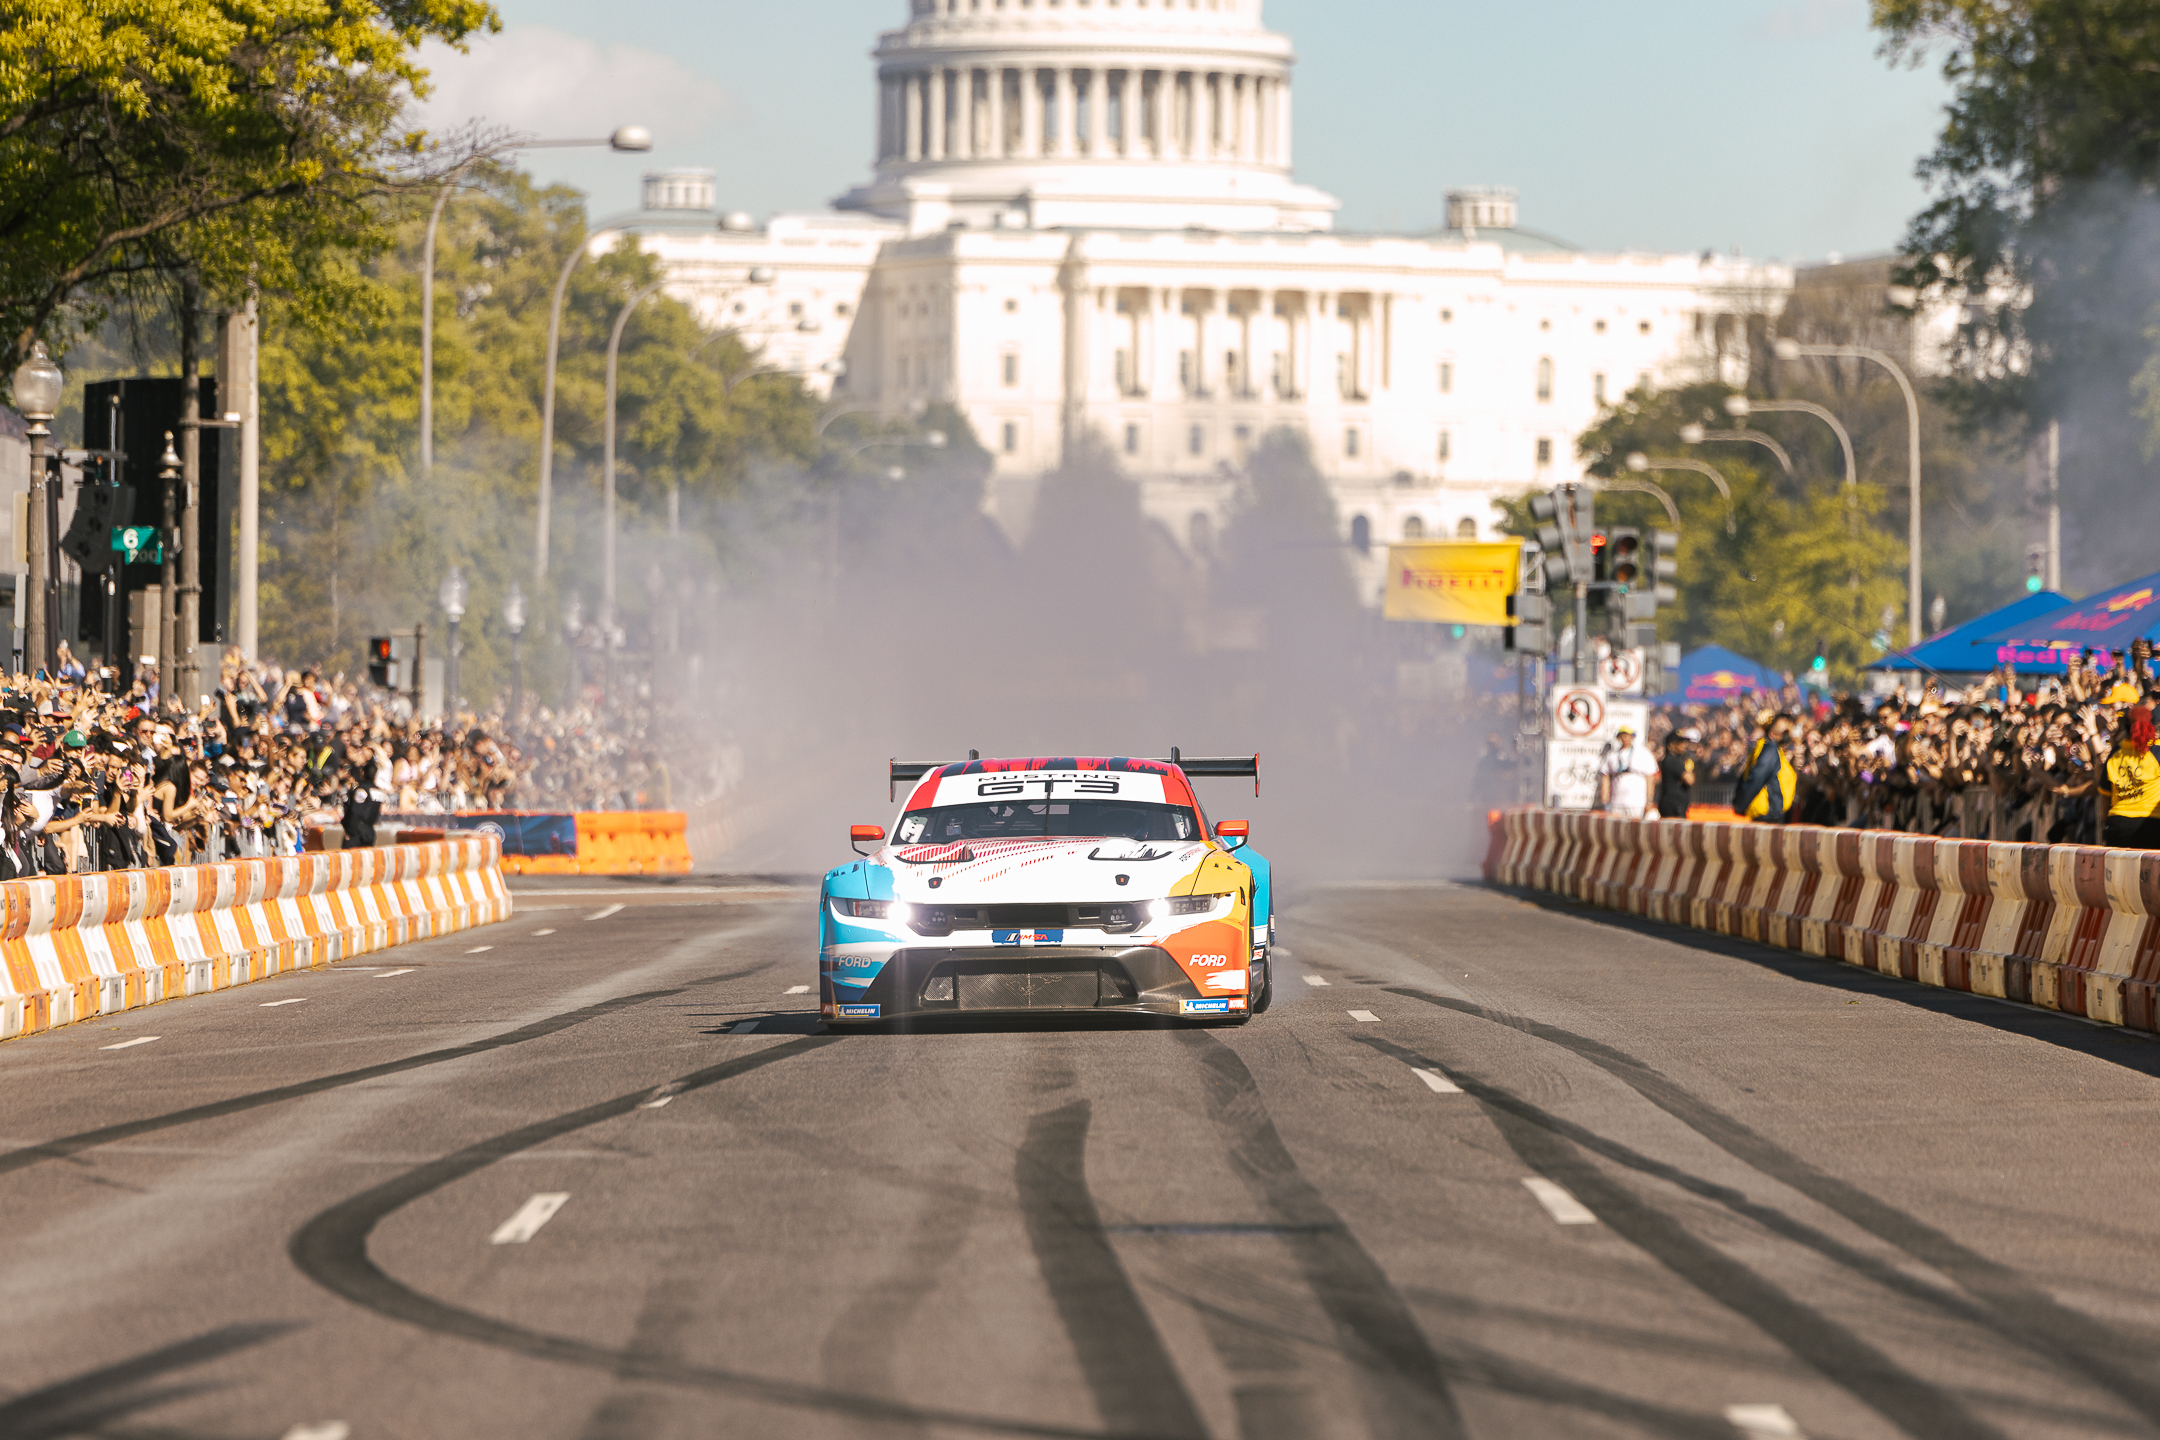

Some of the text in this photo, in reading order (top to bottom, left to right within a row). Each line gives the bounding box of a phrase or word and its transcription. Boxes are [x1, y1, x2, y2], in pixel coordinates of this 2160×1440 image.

[123, 528, 138, 549] 6
[129, 549, 158, 563] 200
[1403, 569, 1503, 590] PIRELLI
[1996, 646, 2057, 664] Red
[978, 774, 1121, 782] MUSTANG
[977, 780, 1119, 796] GT3
[1018, 933, 1049, 941] IMSA
[838, 955, 872, 968] FORD
[1189, 954, 1226, 966] FORD
[1194, 1002, 1227, 1010] MICHELIN
